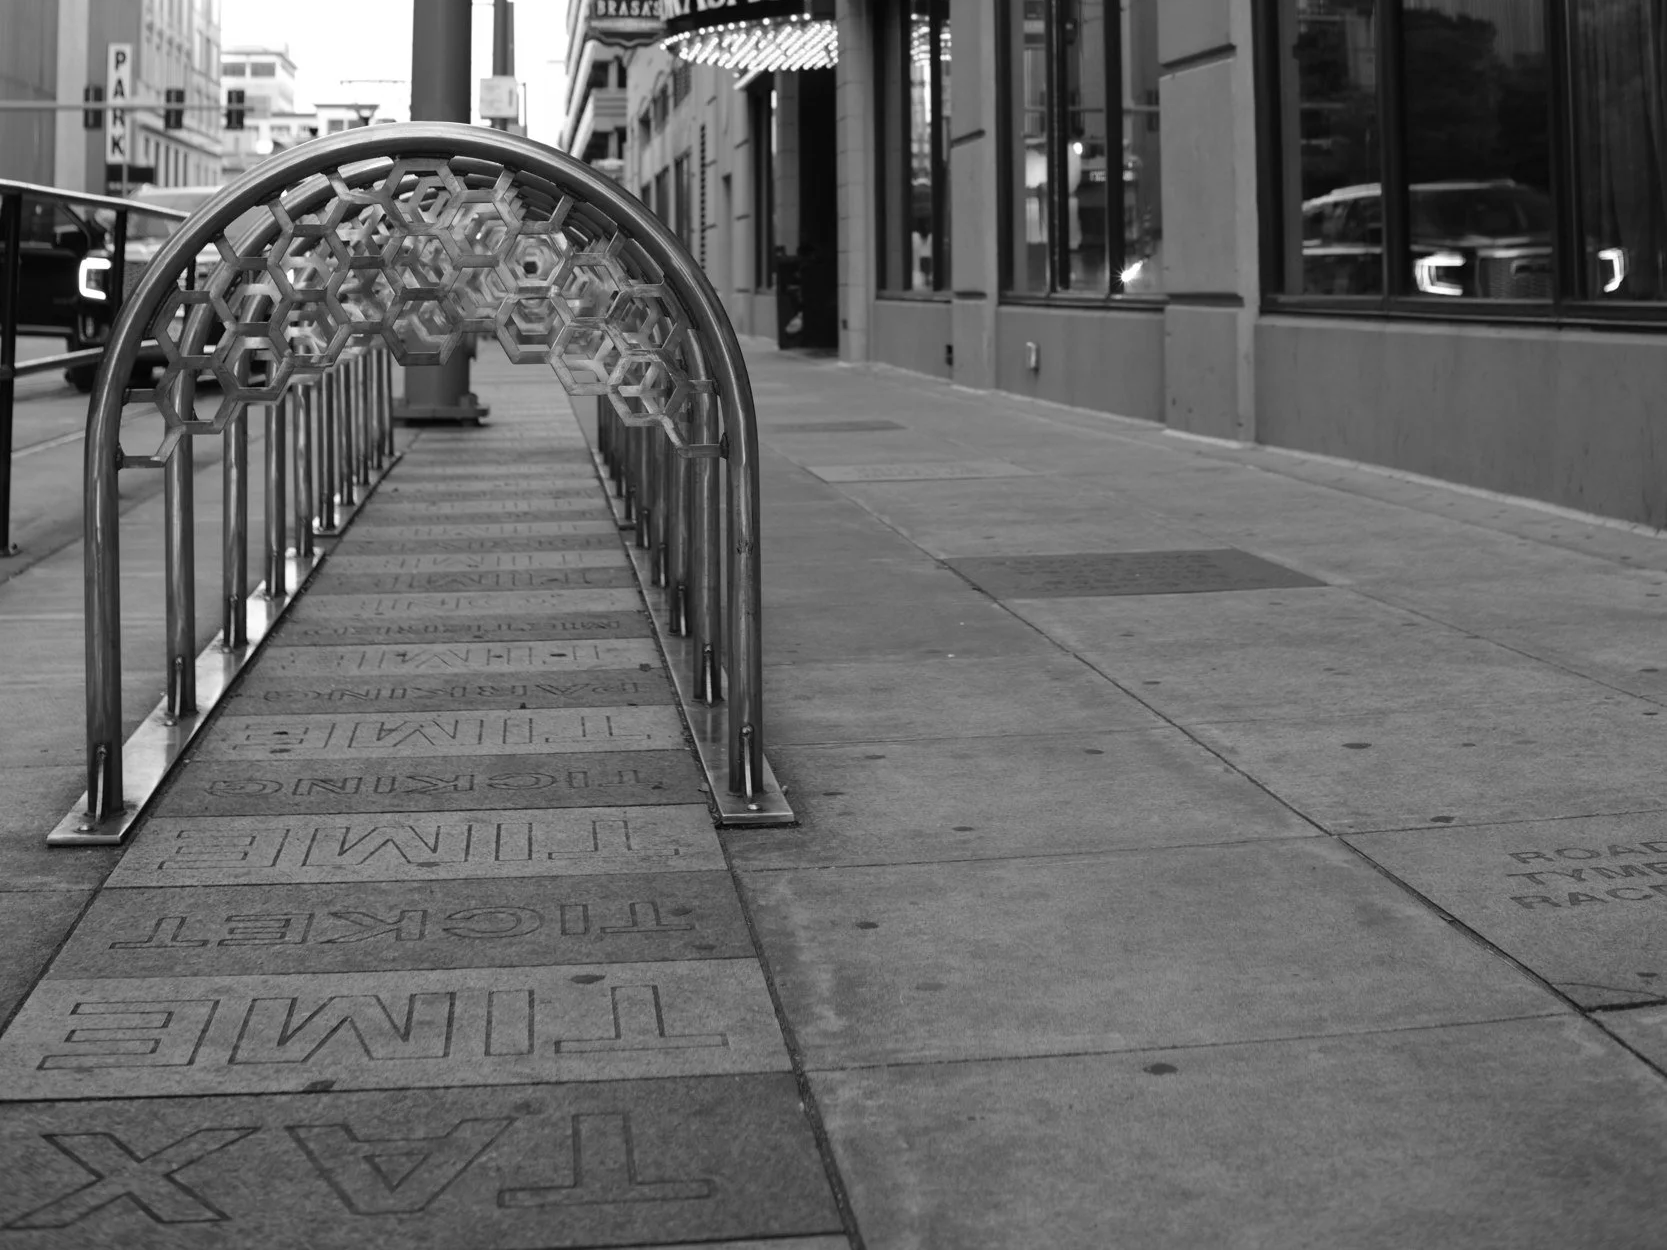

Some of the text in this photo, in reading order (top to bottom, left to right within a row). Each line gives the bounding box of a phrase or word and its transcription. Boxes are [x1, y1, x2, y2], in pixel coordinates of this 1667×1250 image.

[596, 0, 660, 16] BRASA'S
[112, 52, 126, 155] PARK
[262, 680, 643, 704] PARKING
[232, 714, 652, 750] TIME
[204, 768, 664, 798] TICKING
[158, 818, 682, 870] TIME
[109, 900, 694, 949] TICKET
[37, 984, 729, 1070] TIME
[0, 1112, 718, 1230] TAX
